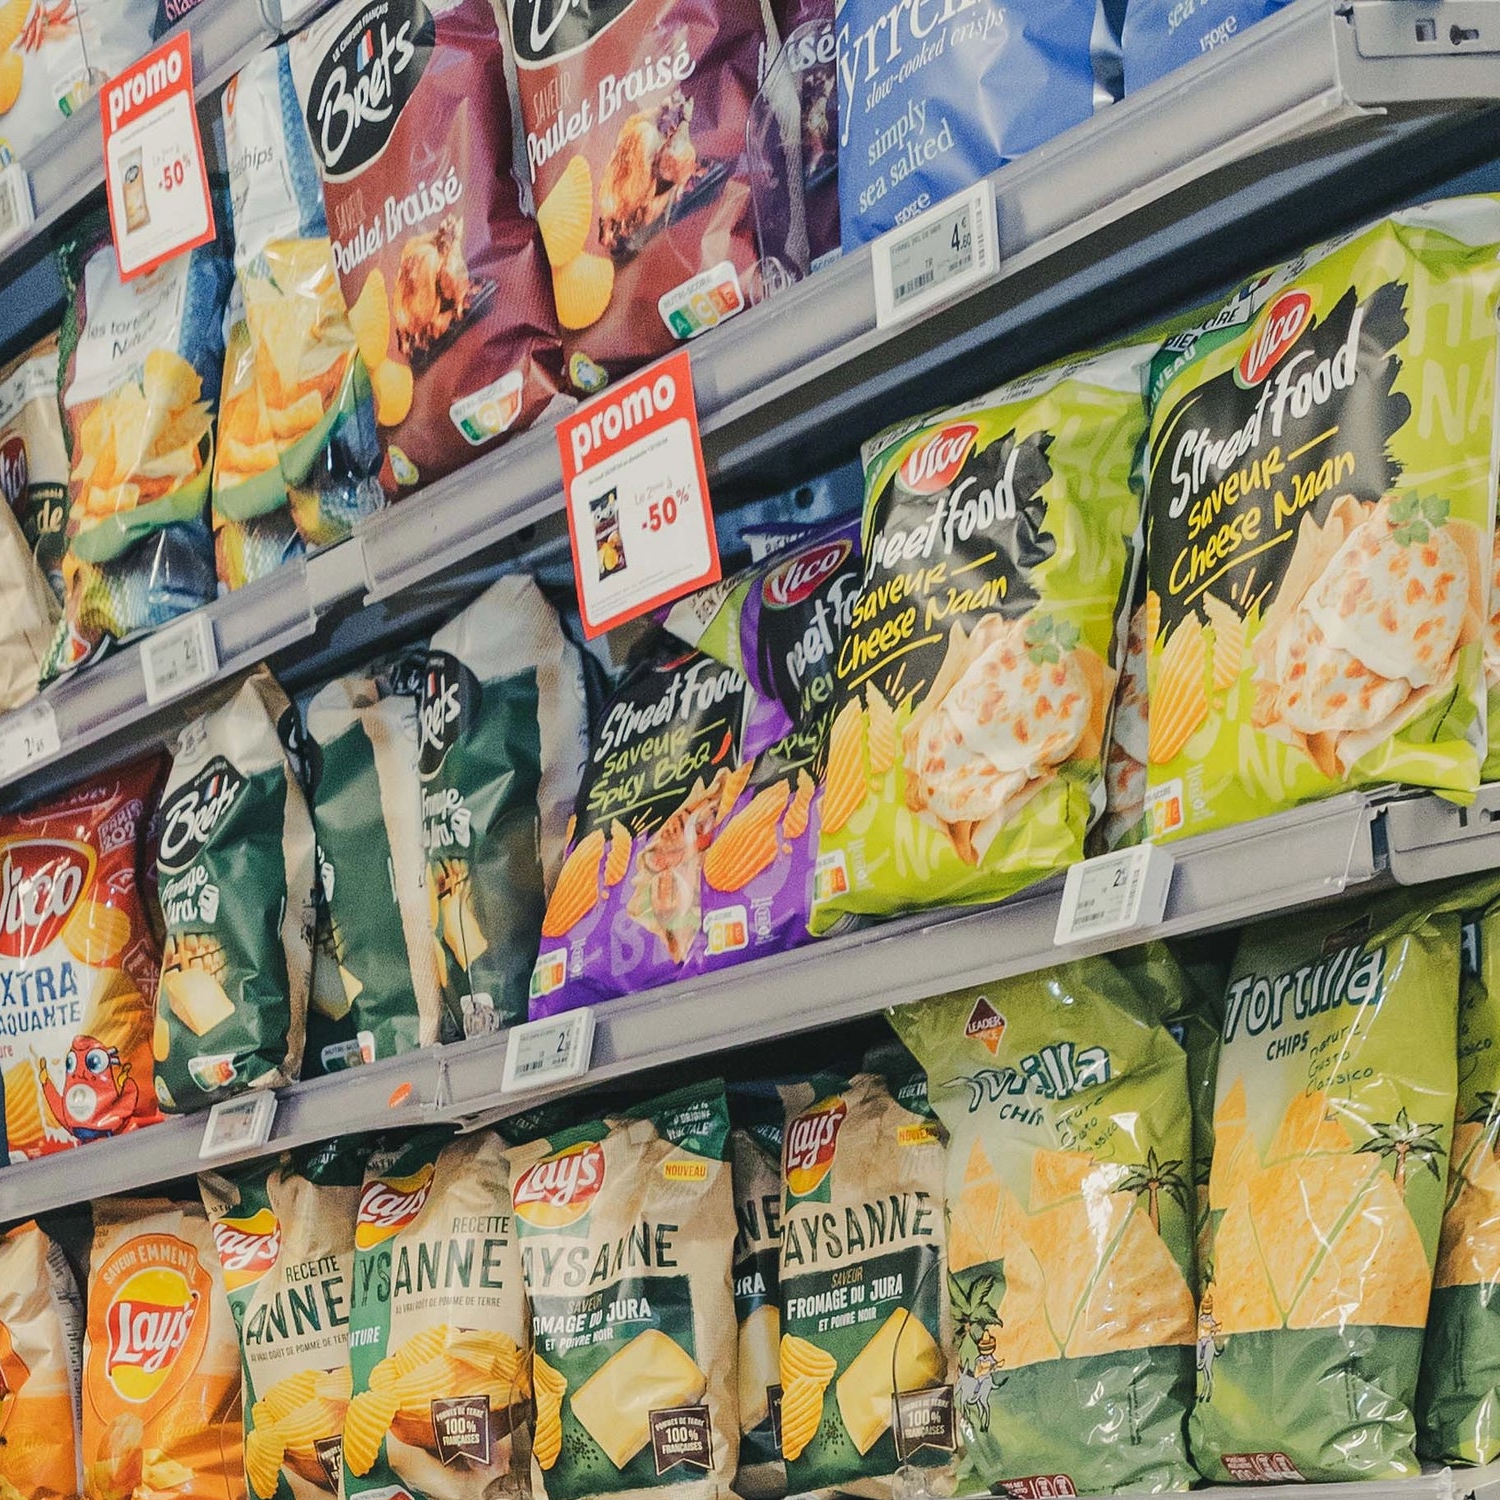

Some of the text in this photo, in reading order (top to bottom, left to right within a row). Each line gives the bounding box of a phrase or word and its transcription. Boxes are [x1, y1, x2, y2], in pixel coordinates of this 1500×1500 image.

[108, 52, 183, 129] promo
[317, 19, 413, 162] Brets
[865, 8, 1006, 113] slow-cooked crisps
[528, 41, 695, 183] Poulet Braisé
[533, 71, 572, 128] SAVEUR
[868, 99, 927, 166] simply
[859, 118, 955, 214] sea salted
[332, 167, 463, 285] Poulet Braisé
[1242, 305, 1305, 381] Vico
[572, 375, 676, 469] promo
[1170, 307, 1364, 518] Street Food
[909, 429, 973, 481] Vico
[641, 490, 690, 534] -50%
[945, 450, 1018, 554] Food
[1170, 451, 1353, 593] Cheese Naan
[1189, 454, 1282, 538] saveur
[839, 574, 1007, 679] Cheese Naan
[852, 565, 948, 627] saveur
[599, 650, 746, 761] Street Food
[589, 742, 711, 813] Spicy BBQ
[604, 725, 691, 778] saveur
[161, 782, 238, 859] Brets
[967, 1015, 1002, 1035] LEADER
[1224, 944, 1386, 1043] Tortilla
[1267, 1030, 1310, 1061] CHIPS
[665, 1165, 706, 1177] NOUVEAU
[786, 1108, 843, 1168] Lay's
[516, 1148, 599, 1207] Lay's
[452, 1216, 510, 1234] RECETTE
[781, 1192, 934, 1268] PAYSANNE
[286, 1255, 340, 1283] RECETTE
[787, 1272, 904, 1321] FROMAGE DU JURA
[112, 1300, 196, 1371] Lay's
[560, 1327, 614, 1349] POIVRE NOIR
[607, 1298, 652, 1322] JURA
[445, 1420, 477, 1435] 100%
[666, 1427, 698, 1443] 100%
